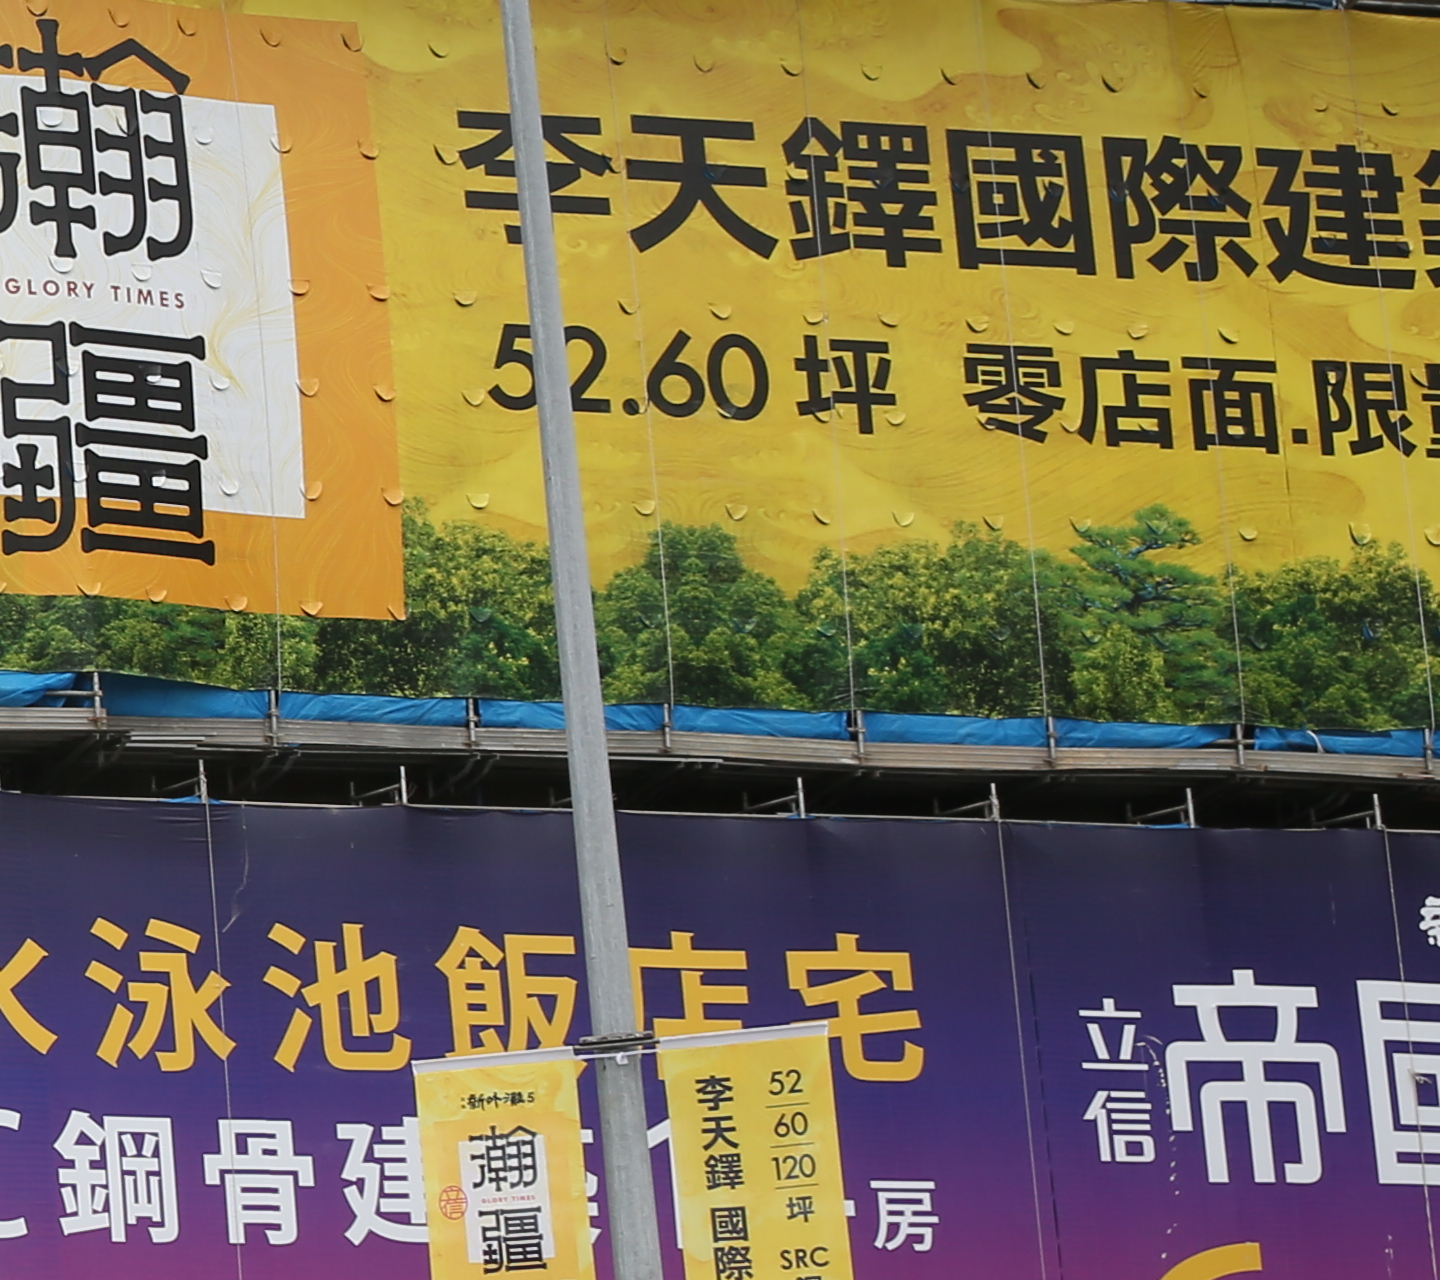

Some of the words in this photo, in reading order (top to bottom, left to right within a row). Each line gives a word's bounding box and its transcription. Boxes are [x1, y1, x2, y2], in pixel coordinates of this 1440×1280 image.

[455, 109, 1440, 292] 李天鐸國際建
[4, 276, 97, 301] GLORY
[110, 283, 187, 311] TIMES
[963, 342, 1440, 460] 零店面.限
[767, 1068, 804, 1097] 52
[1078, 997, 1157, 1163] 立信
[773, 1110, 809, 1138] 60
[771, 1153, 816, 1182] 120
[481, 1195, 509, 1205] GLORY
[511, 1193, 537, 1202] TIMES
[785, 1195, 815, 1223] 坪
[779, 1246, 830, 1270] SRC
